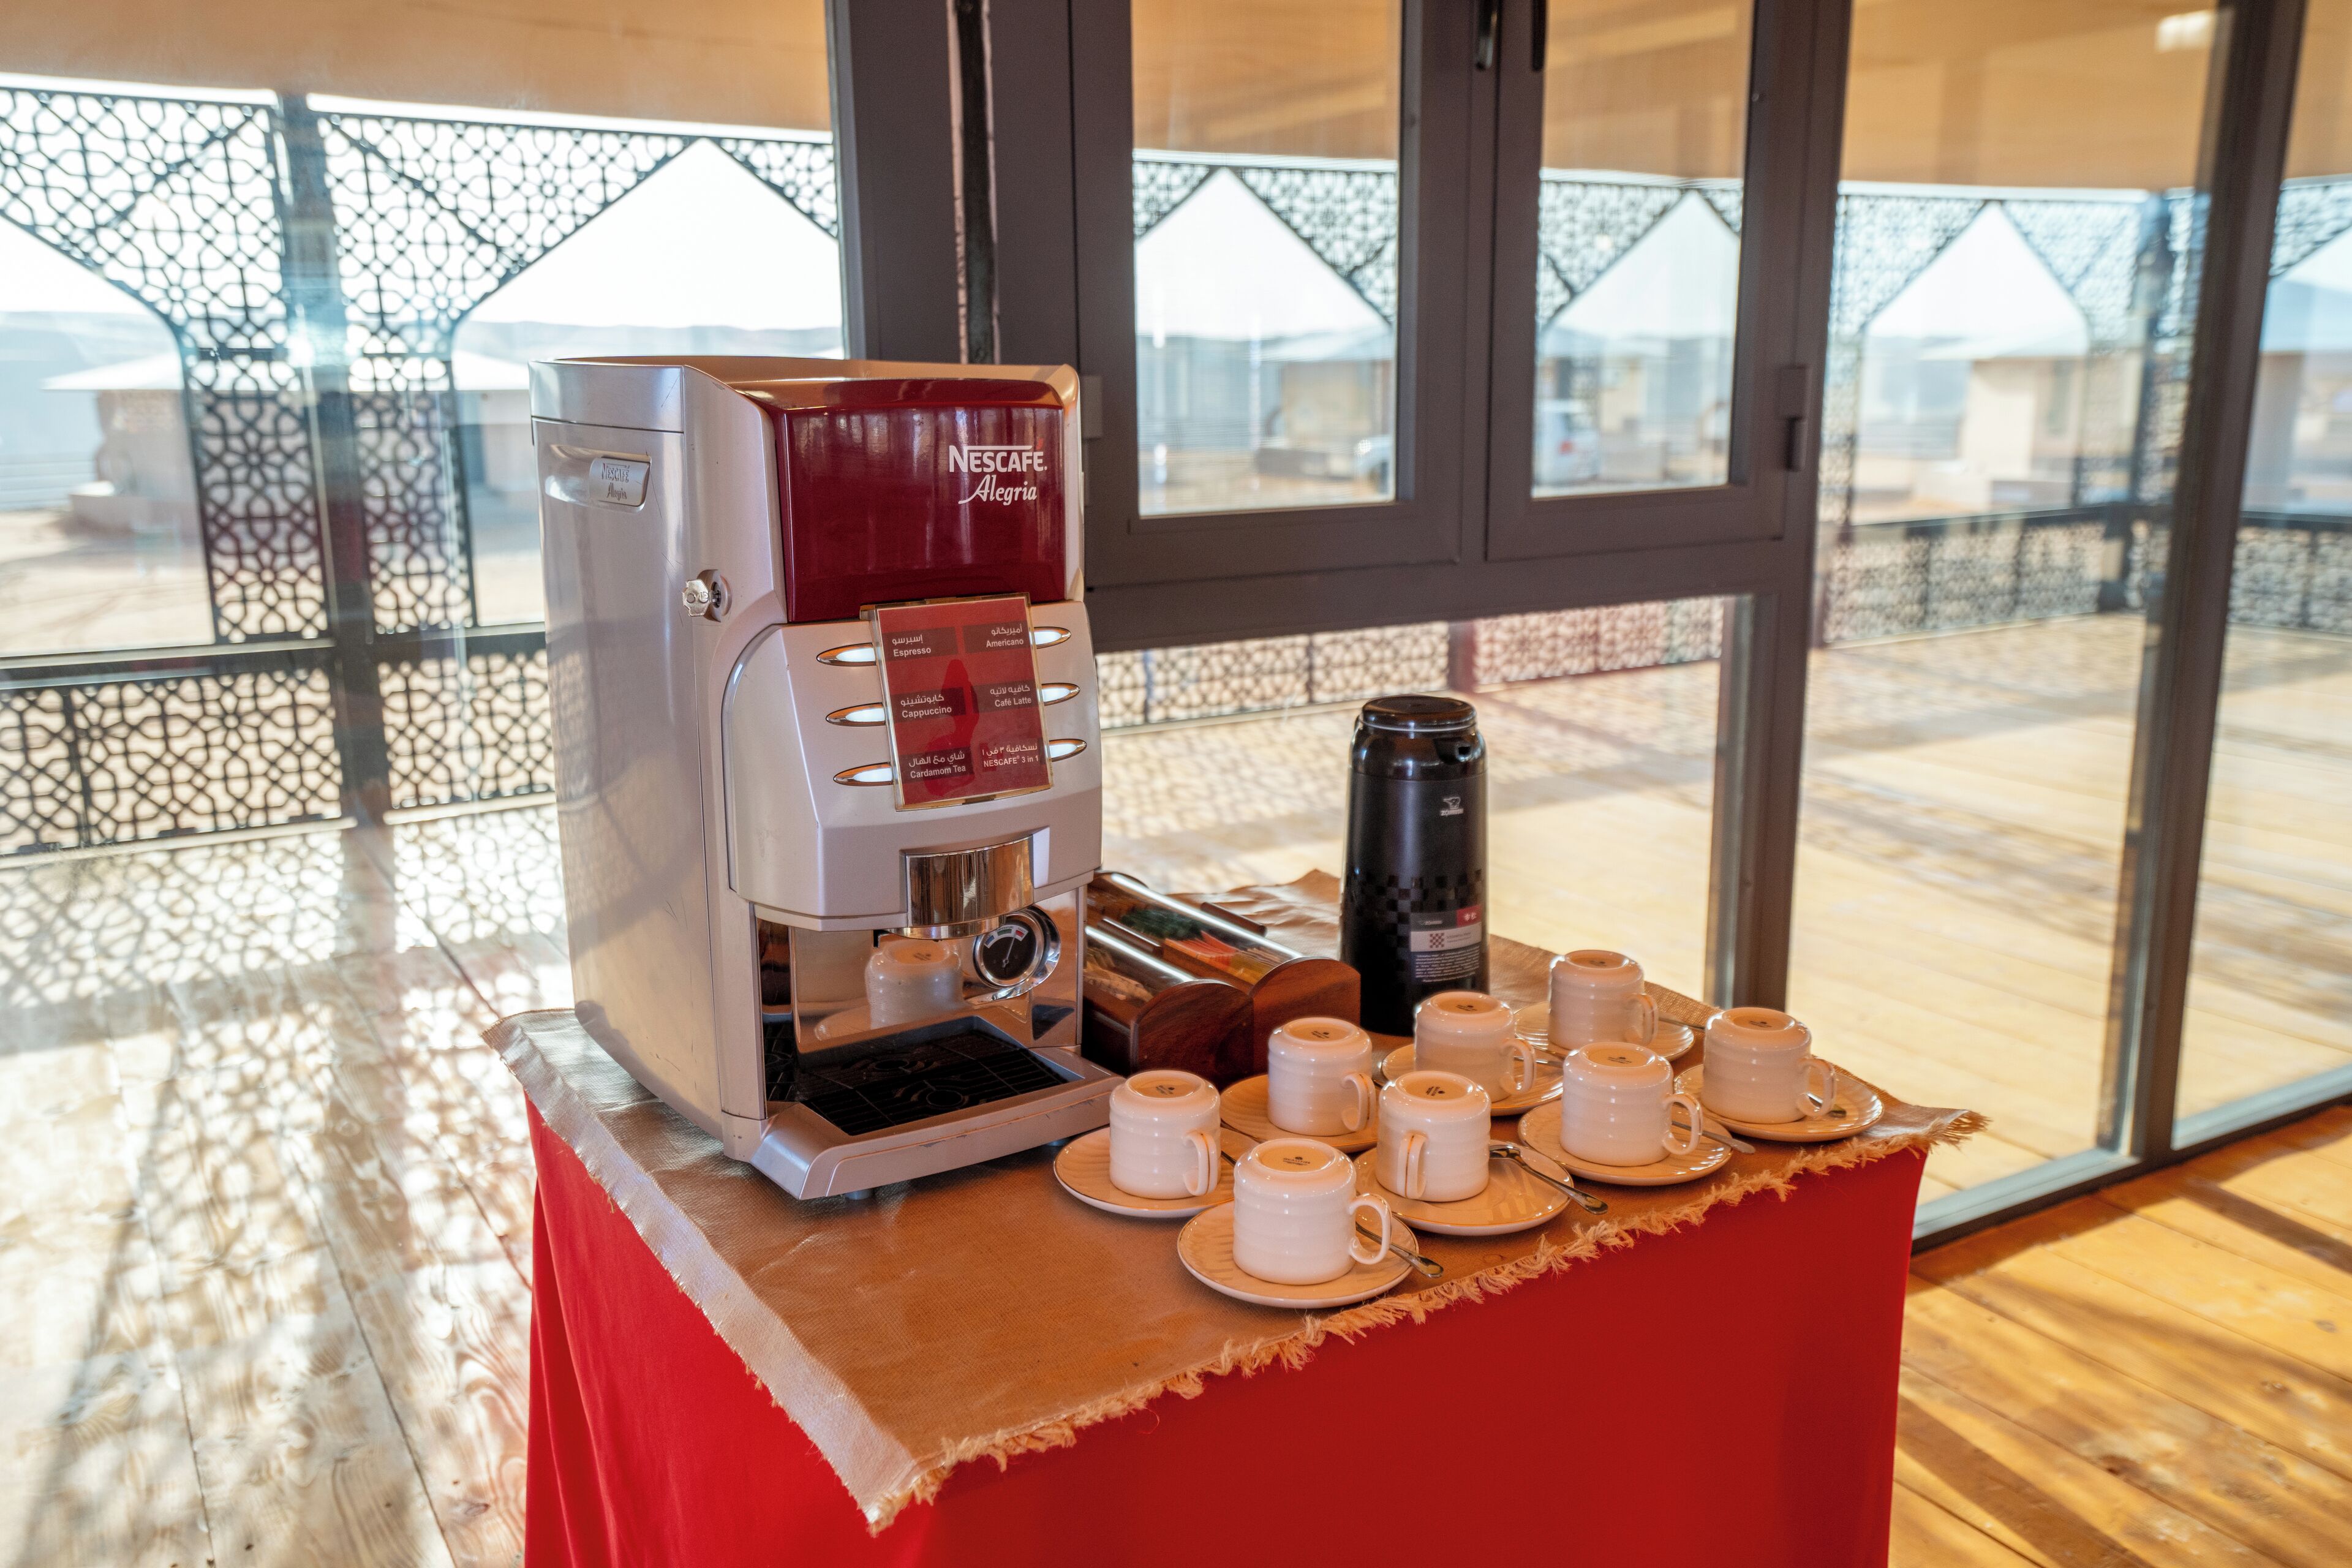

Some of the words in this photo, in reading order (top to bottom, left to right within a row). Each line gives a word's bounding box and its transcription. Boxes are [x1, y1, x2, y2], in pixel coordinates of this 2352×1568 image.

[606, 482, 627, 501] Alegria
[958, 474, 1037, 506] Alegria
[991, 624, 1023, 636] أميريكانو
[892, 634, 924, 646] إسبرسو
[986, 638, 1023, 647] Americano
[893, 646, 932, 658] Espresso
[990, 685, 1007, 697] لاتيه
[1008, 685, 1030, 695] كافيه
[900, 694, 944, 707] كابوتشينو
[995, 698, 1012, 707] Café
[902, 706, 952, 719] Cappuccino
[986, 747, 998, 758] في
[1006, 743, 1038, 754] نسكافية
[908, 756, 931, 768] الهال
[933, 756, 945, 764] مع
[947, 750, 965, 764] شاي
[910, 766, 951, 778] Cardamom
[954, 764, 966, 773] Tea
